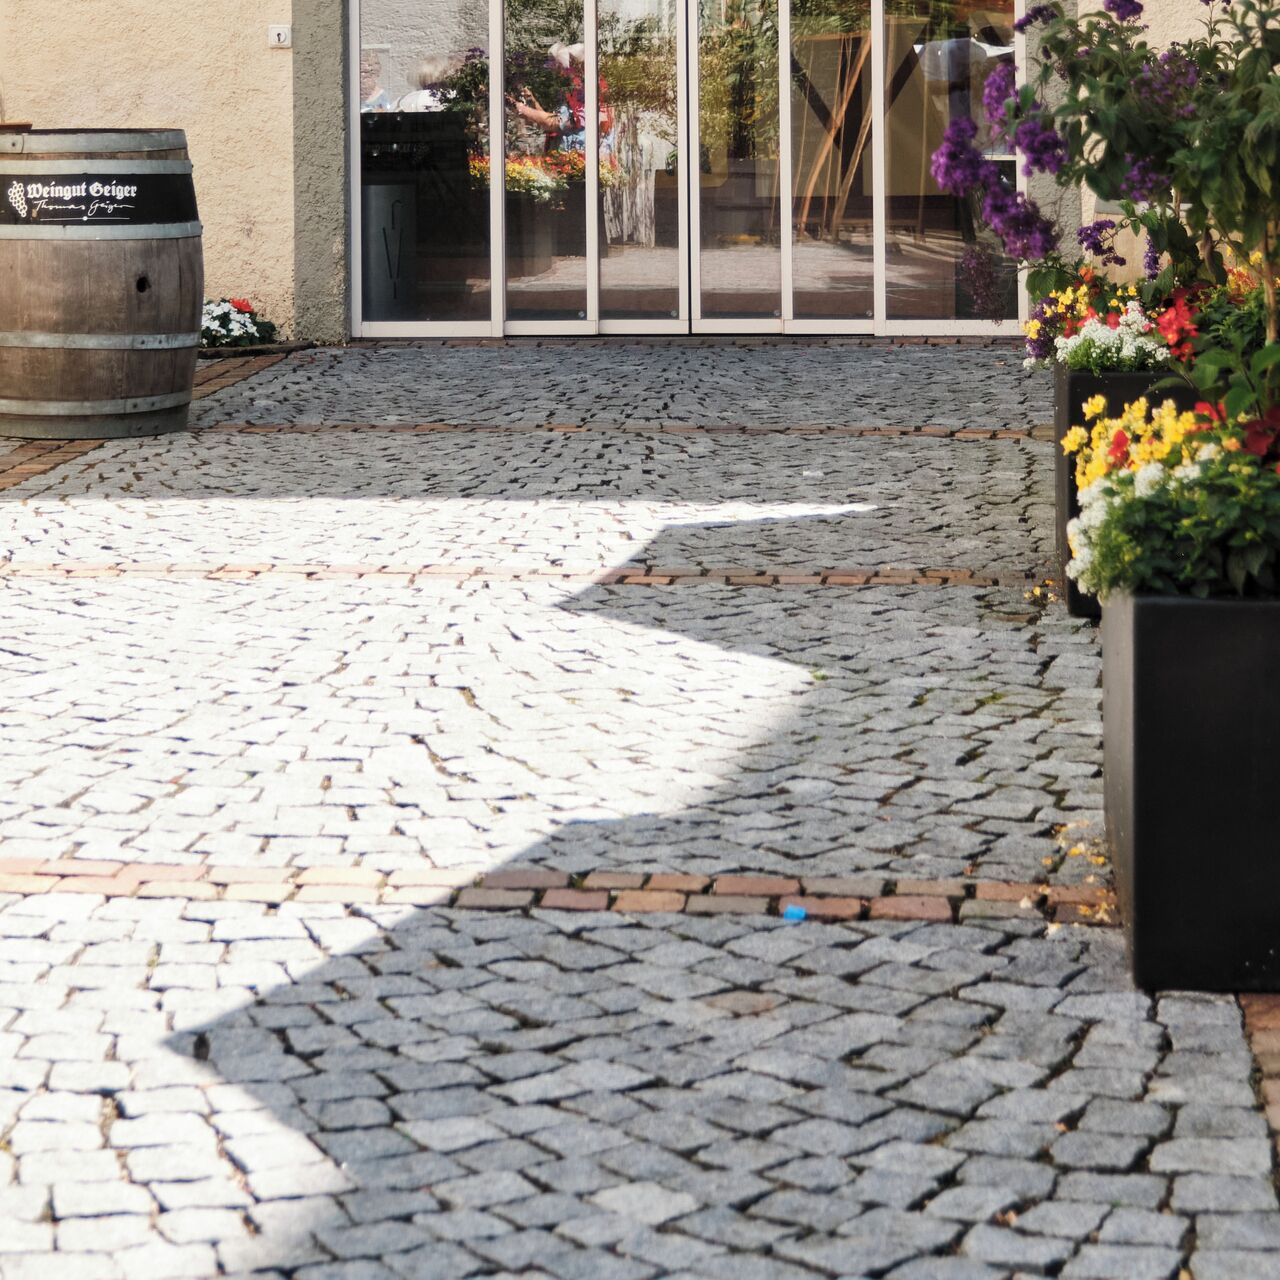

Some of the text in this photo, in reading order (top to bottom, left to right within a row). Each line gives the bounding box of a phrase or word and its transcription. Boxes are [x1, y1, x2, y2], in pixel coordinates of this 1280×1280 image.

[27, 180, 137, 200] Weingut Geiger
[33, 199, 86, 212] Thomas
